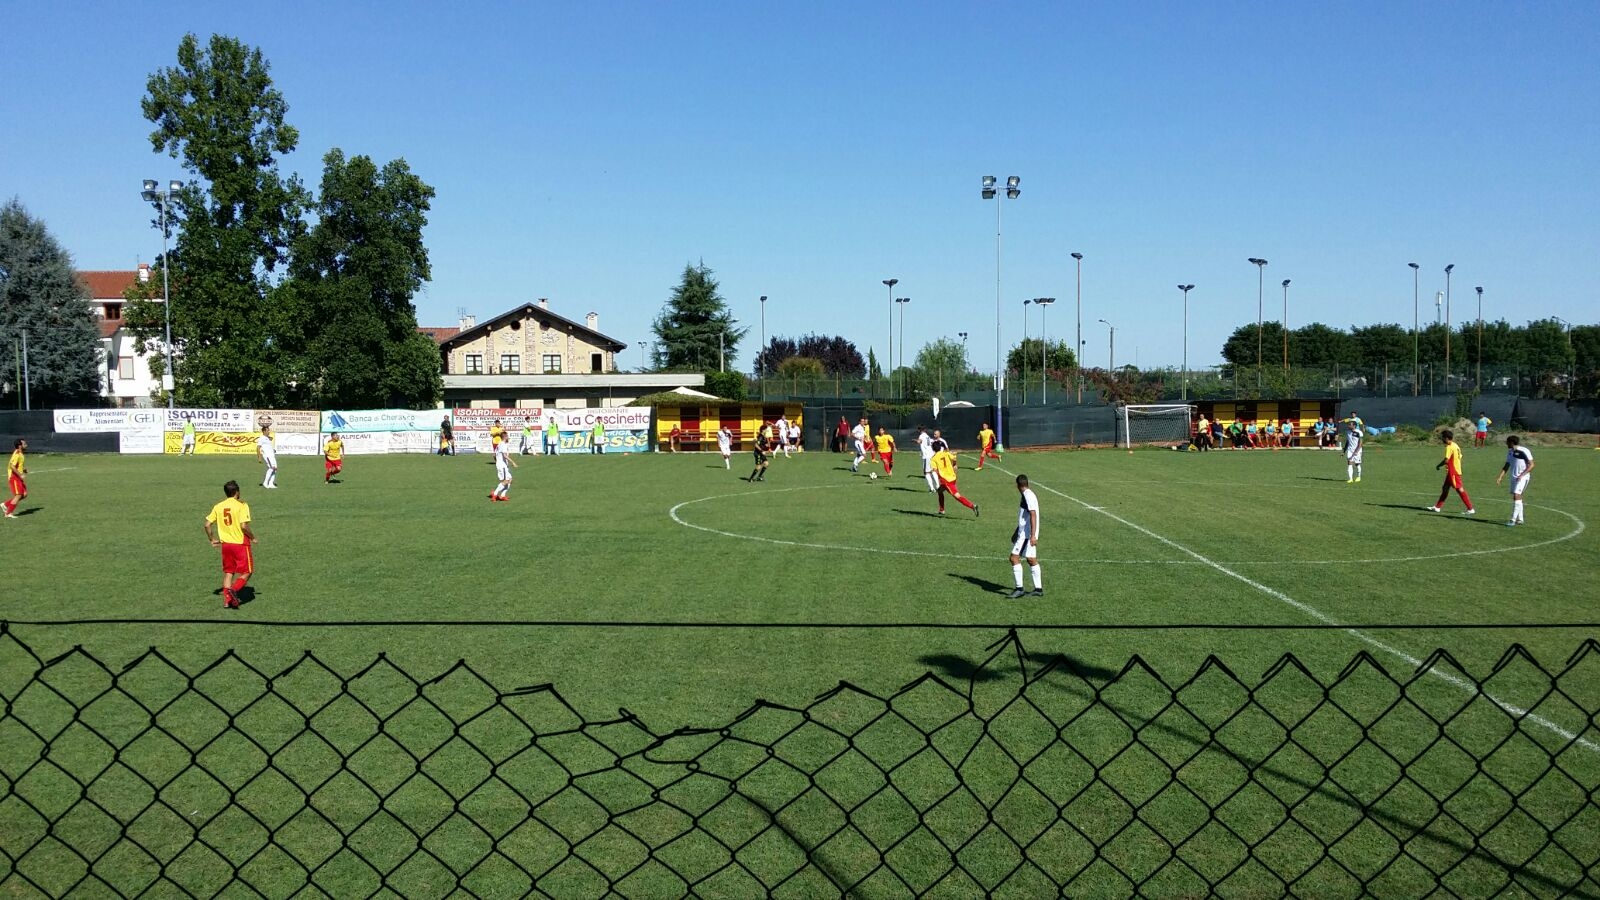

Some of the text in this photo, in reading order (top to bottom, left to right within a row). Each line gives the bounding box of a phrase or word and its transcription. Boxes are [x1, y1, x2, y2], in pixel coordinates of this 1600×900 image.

[61, 414, 82, 424] GEI
[134, 413, 155, 424] GEI
[566, 415, 581, 426] La
[940, 457, 947, 468] 7
[223, 508, 233, 526] 5
